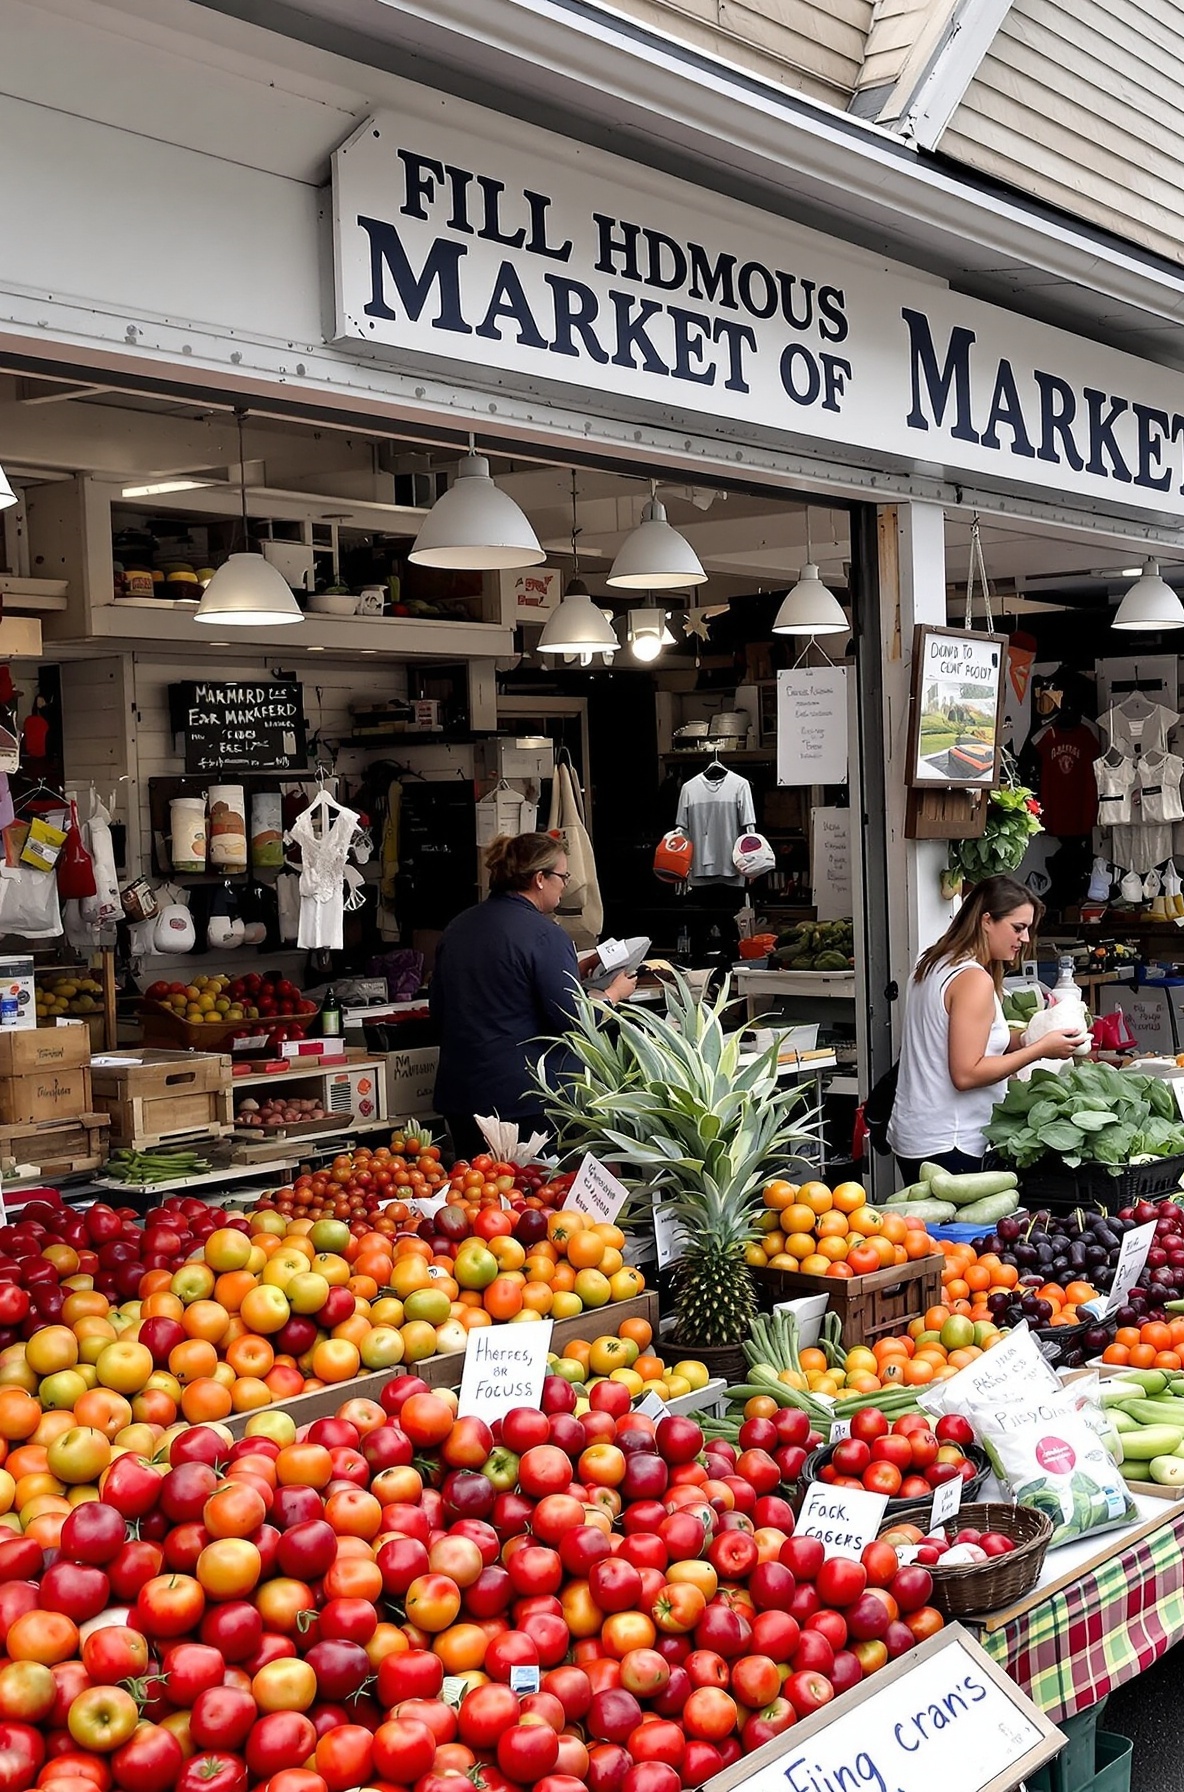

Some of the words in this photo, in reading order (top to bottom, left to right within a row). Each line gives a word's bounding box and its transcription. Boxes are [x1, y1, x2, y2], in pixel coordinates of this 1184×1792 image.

[357, 215, 758, 395] MARKET
[779, 343, 853, 413] OF
[397, 149, 573, 263] FILL
[593, 212, 848, 343] HDMOUS
